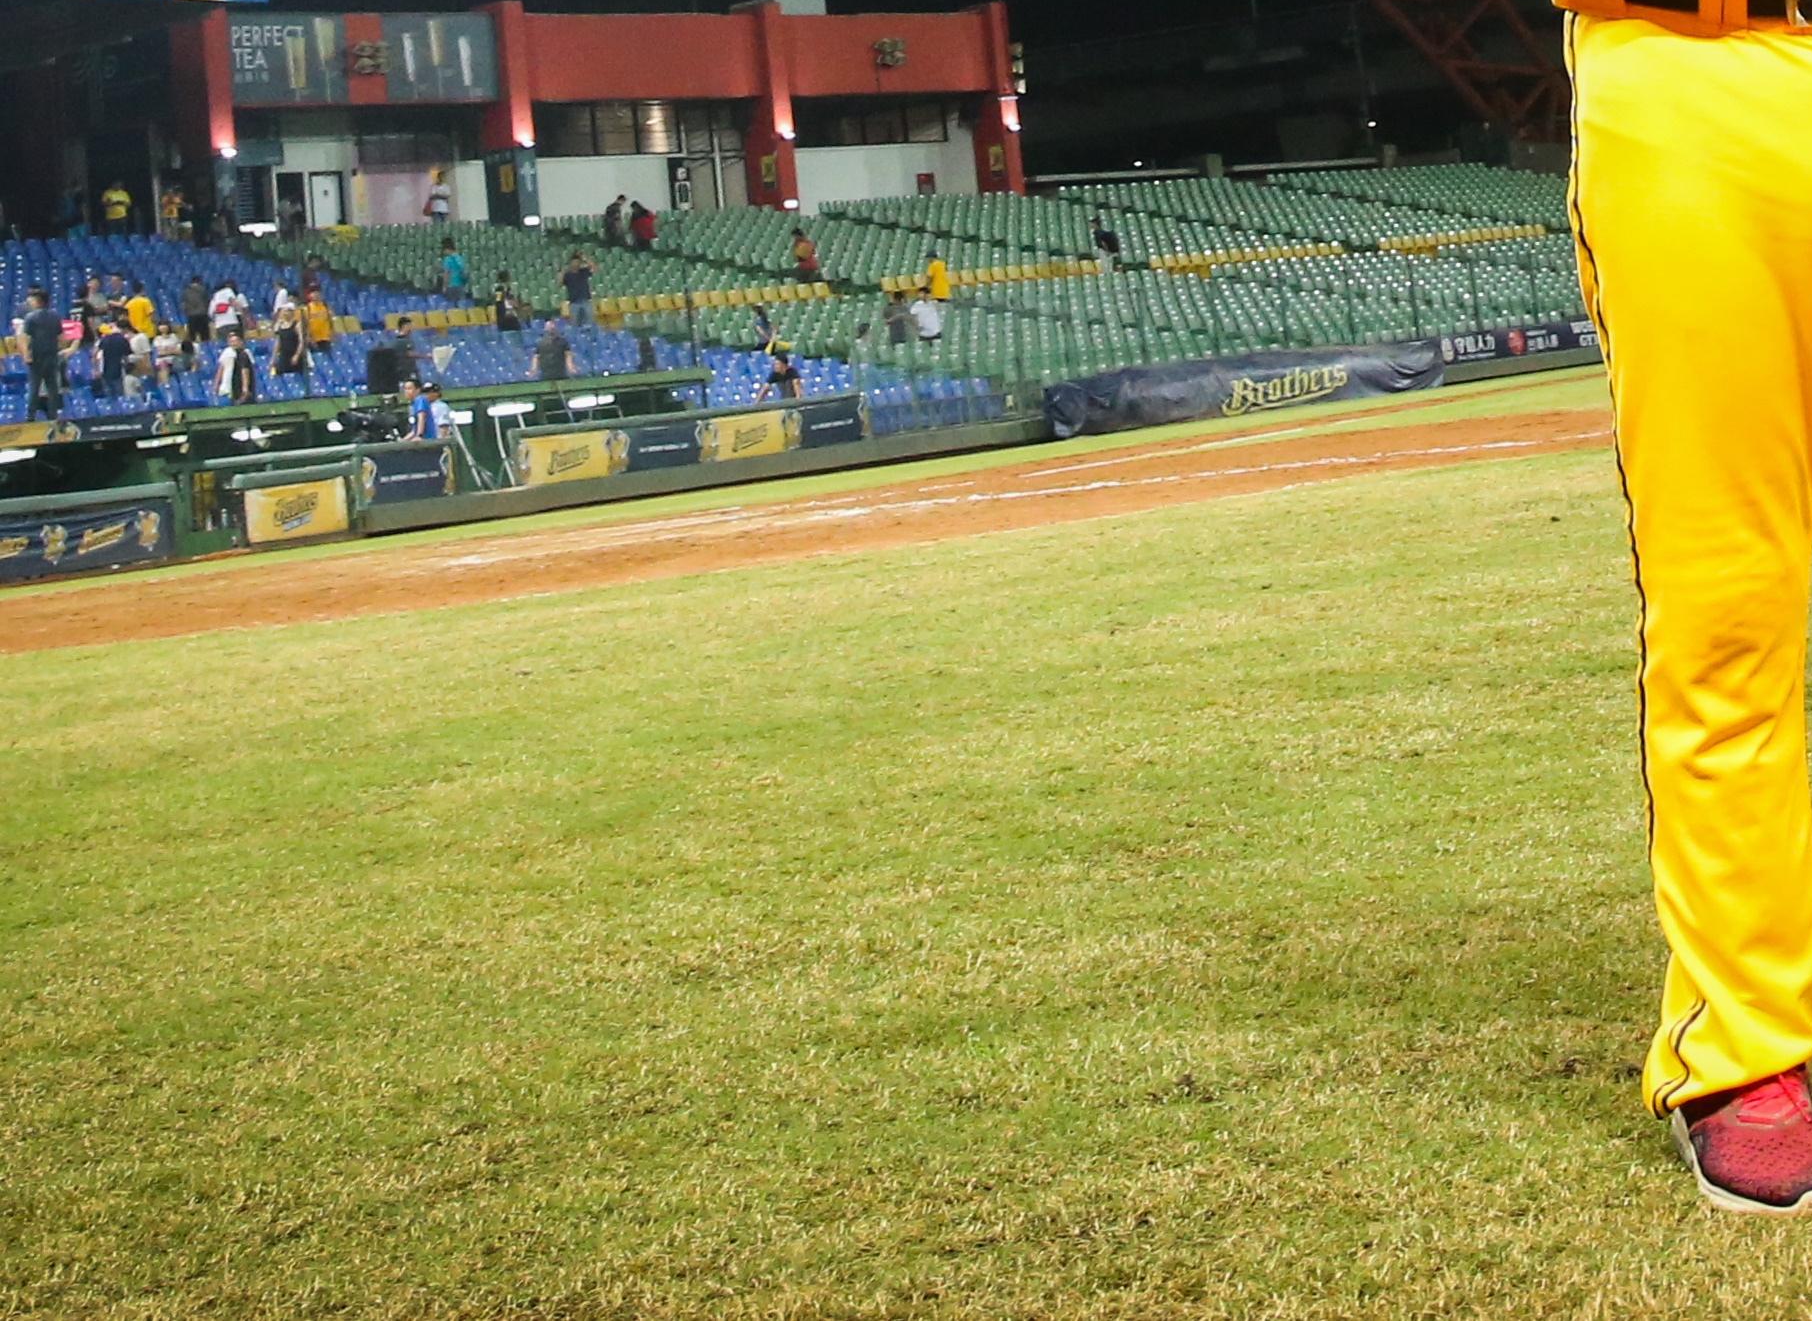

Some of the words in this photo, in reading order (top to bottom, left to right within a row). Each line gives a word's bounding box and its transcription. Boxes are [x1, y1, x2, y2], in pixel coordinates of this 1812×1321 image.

[231, 25, 304, 47] PERFECT
[233, 48, 268, 69] TEA
[1220, 363, 1349, 417] Brothers
